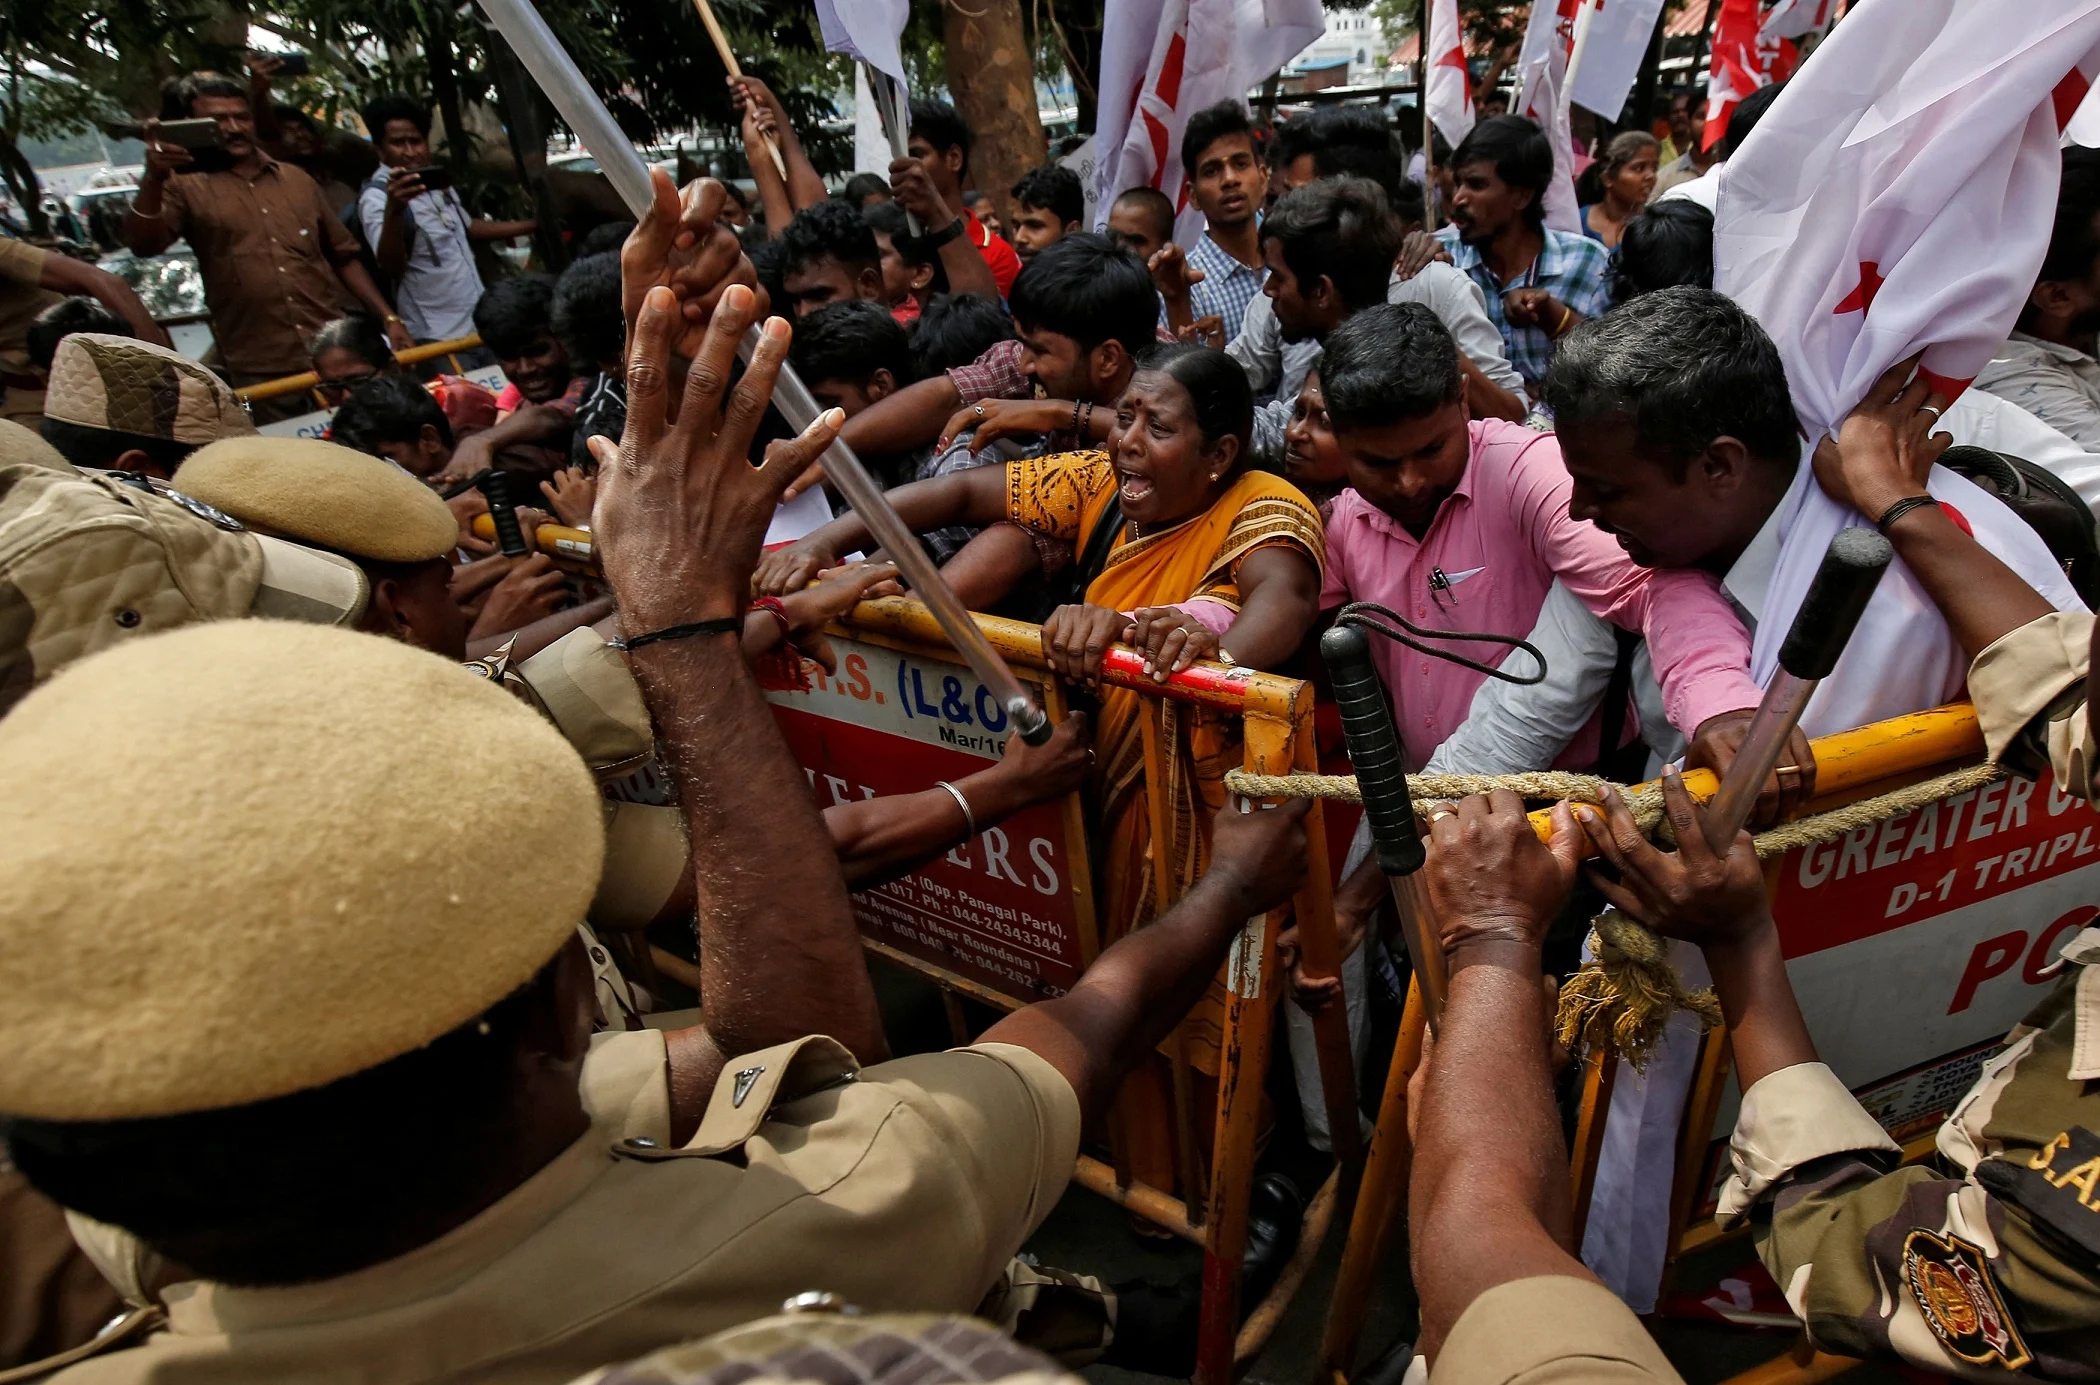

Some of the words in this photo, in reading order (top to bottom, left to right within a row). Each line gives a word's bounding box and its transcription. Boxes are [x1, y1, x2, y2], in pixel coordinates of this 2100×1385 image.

[1799, 773, 2037, 889] GREATER
[920, 876, 956, 900] (Opp.
[958, 890, 1018, 921] Panagal
[1021, 912, 1068, 940] Park),
[1884, 869, 1957, 918] D-1
[1974, 826, 2100, 891] TRIPL
[871, 897, 918, 926] Avenue,
[962, 933, 1032, 970] Roundana
[952, 905, 1063, 955] 044-24343344
